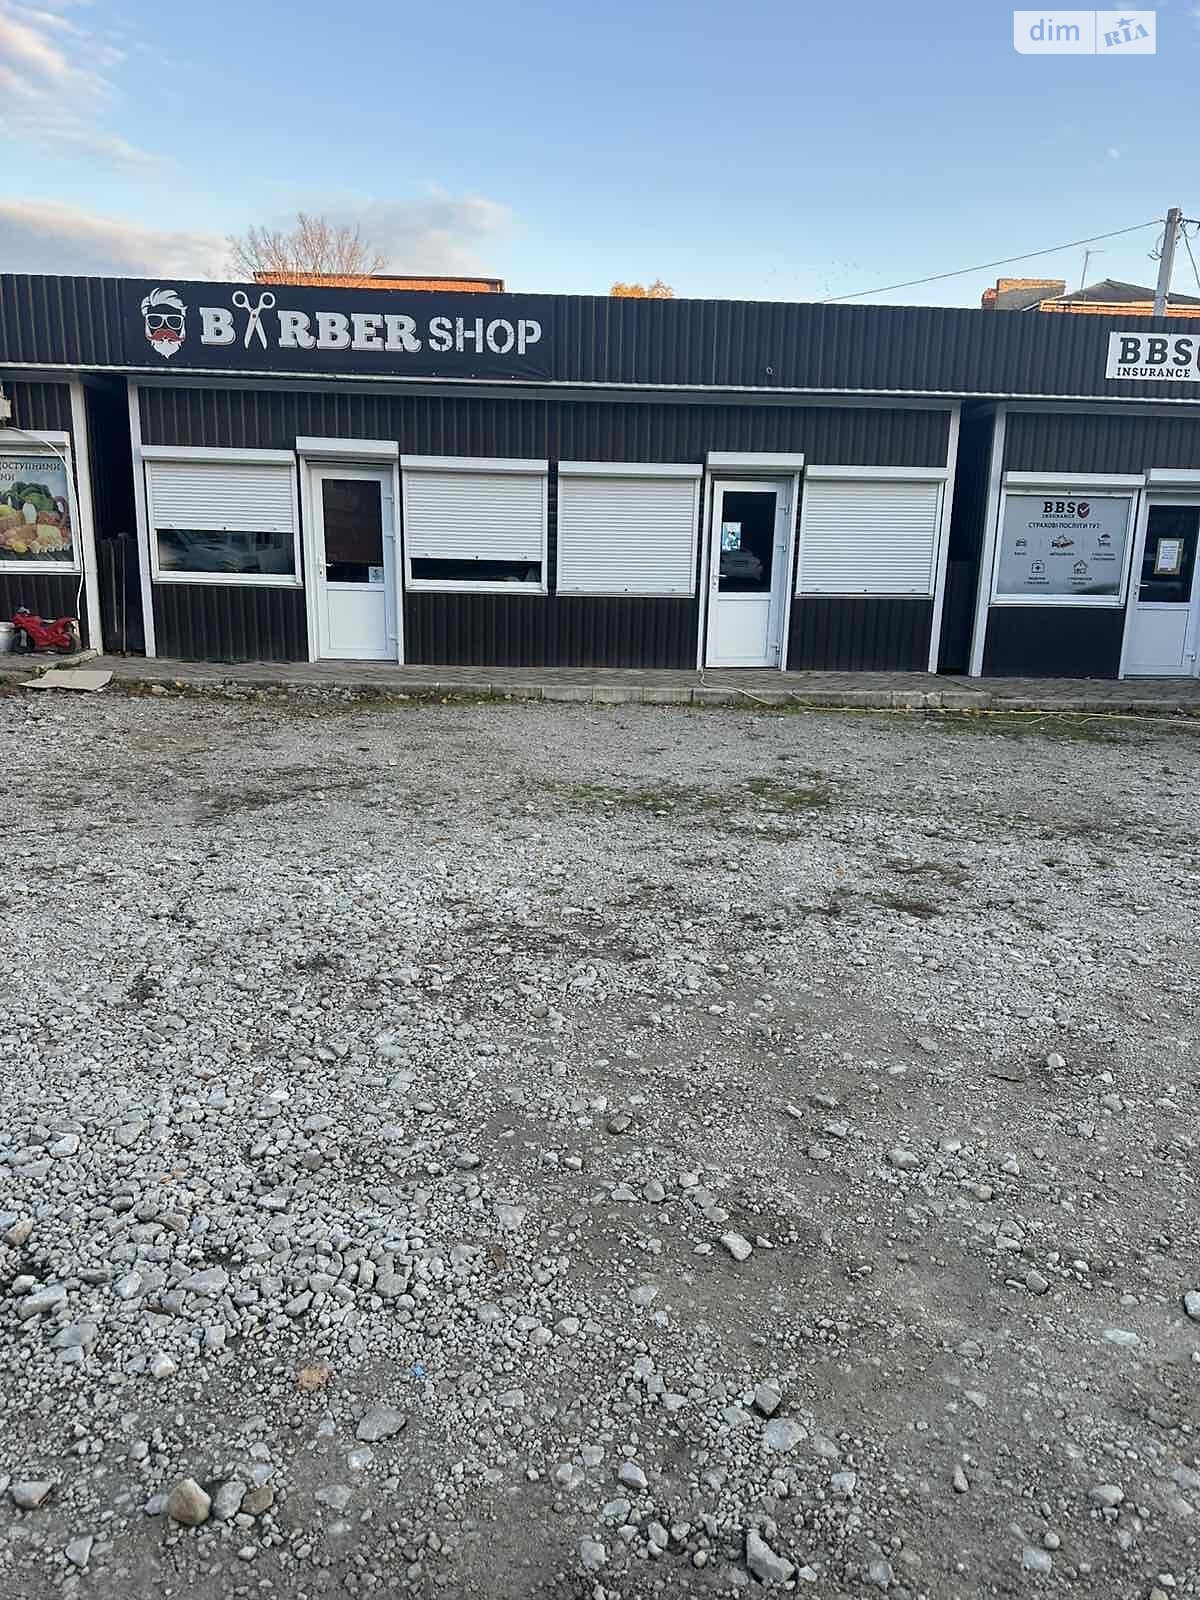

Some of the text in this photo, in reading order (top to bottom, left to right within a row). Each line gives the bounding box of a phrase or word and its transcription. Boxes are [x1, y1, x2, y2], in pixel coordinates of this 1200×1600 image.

[428, 316, 542, 354] SHOP
[1118, 337, 1193, 366] BBS
[1117, 367, 1191, 378] INSURANCE
[0, 462, 61, 471] ОСТУПНИМИ
[1043, 501, 1076, 513] BBS
